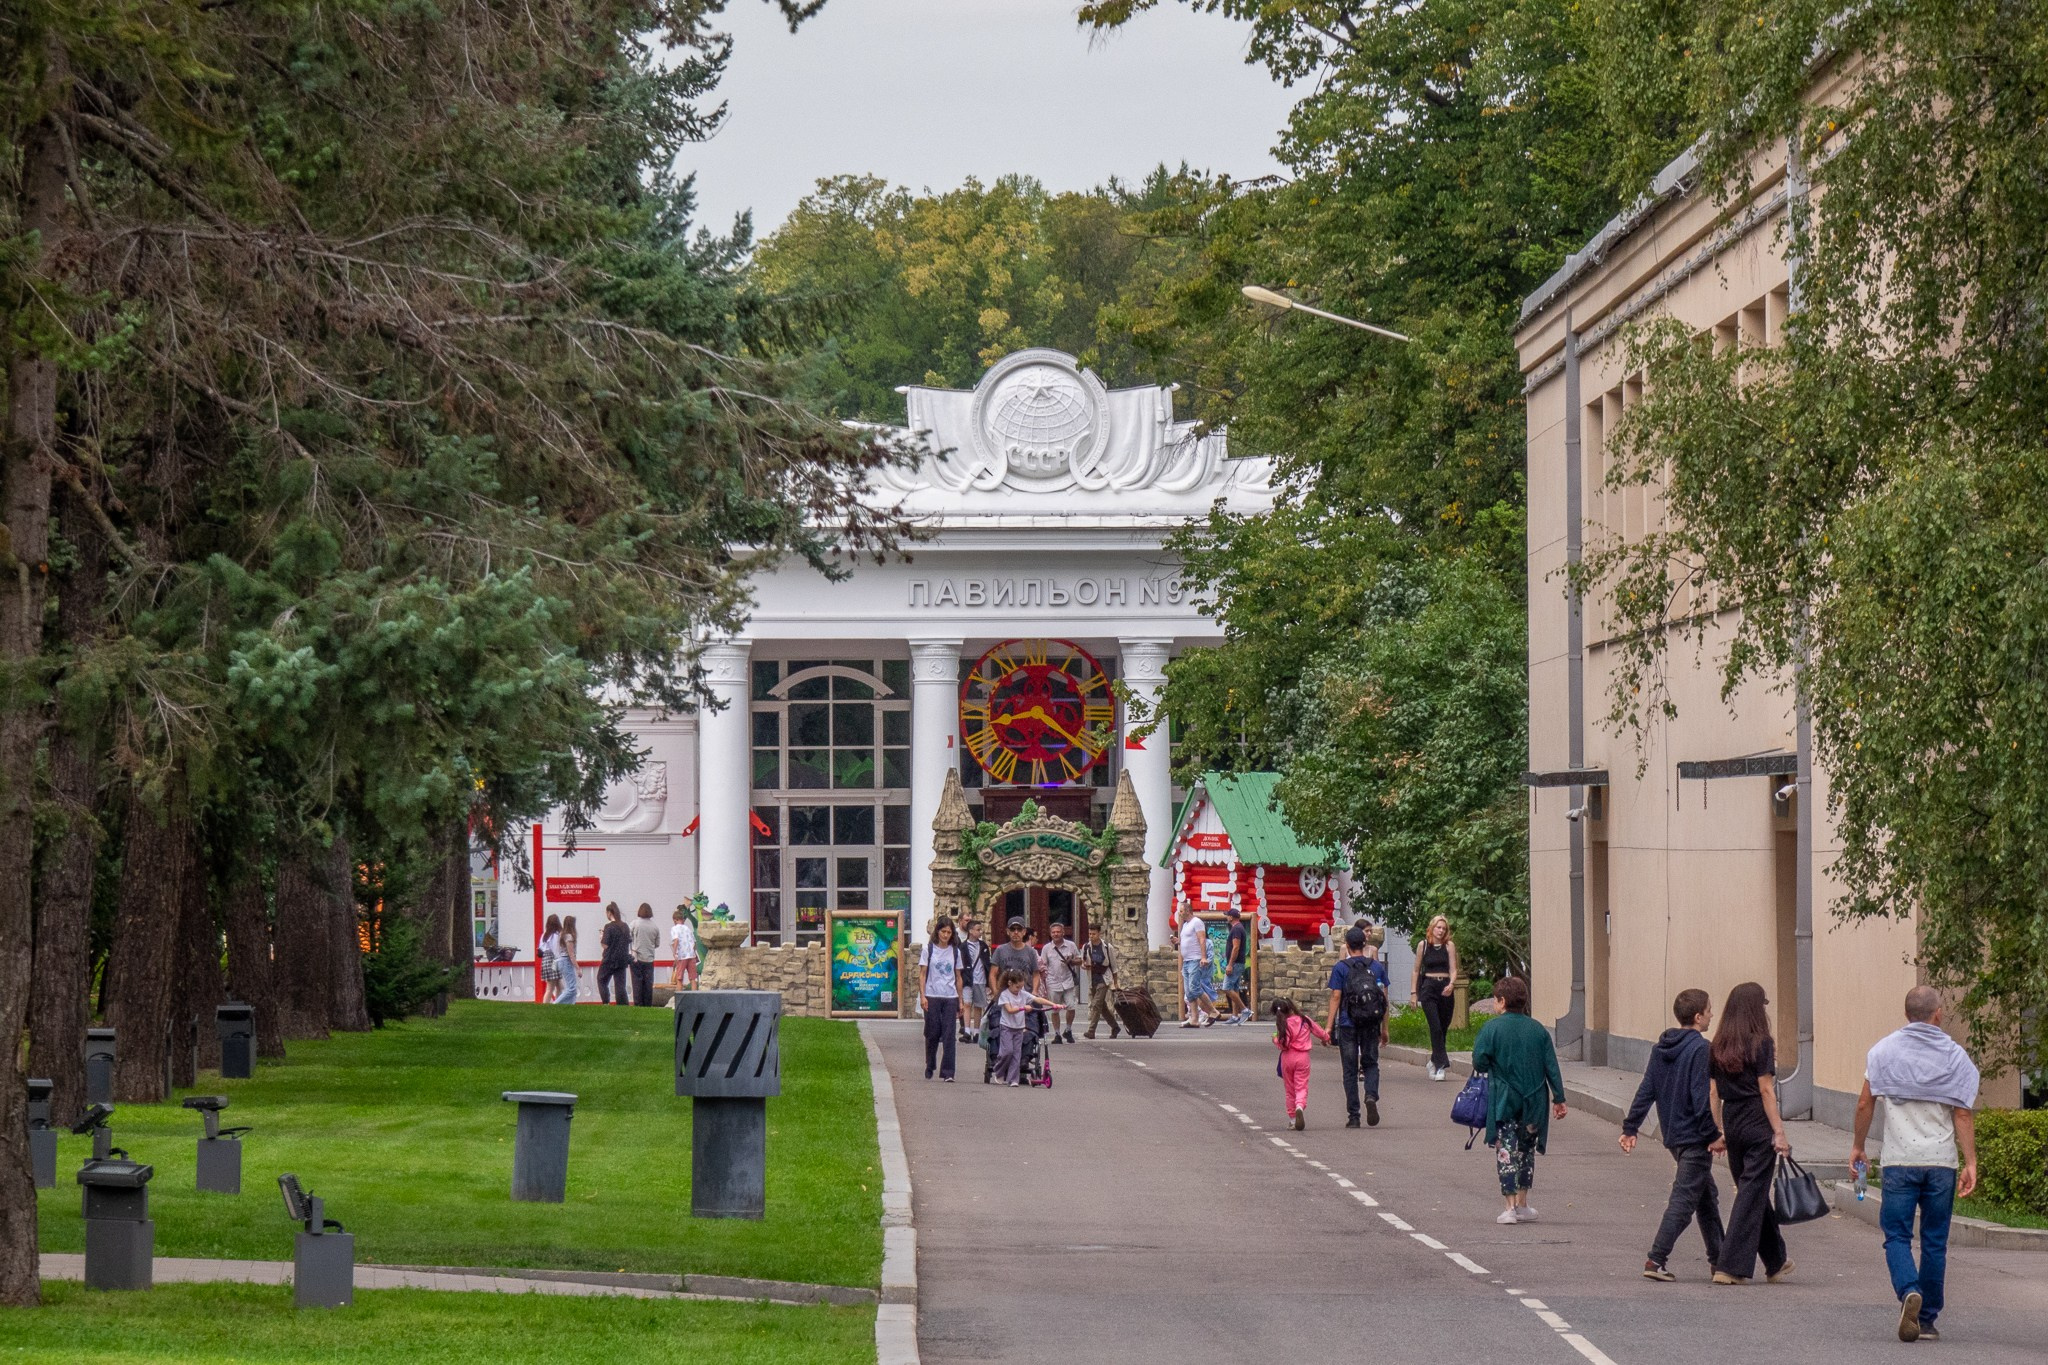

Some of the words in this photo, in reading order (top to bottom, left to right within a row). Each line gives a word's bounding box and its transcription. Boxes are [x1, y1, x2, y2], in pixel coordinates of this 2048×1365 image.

[1008, 445, 1068, 471] СССР
[908, 578, 1126, 606] ПАВИЛЬОН
[992, 835, 1035, 857] ТЕАТР
[1037, 833, 1092, 859] СКАЗОК
